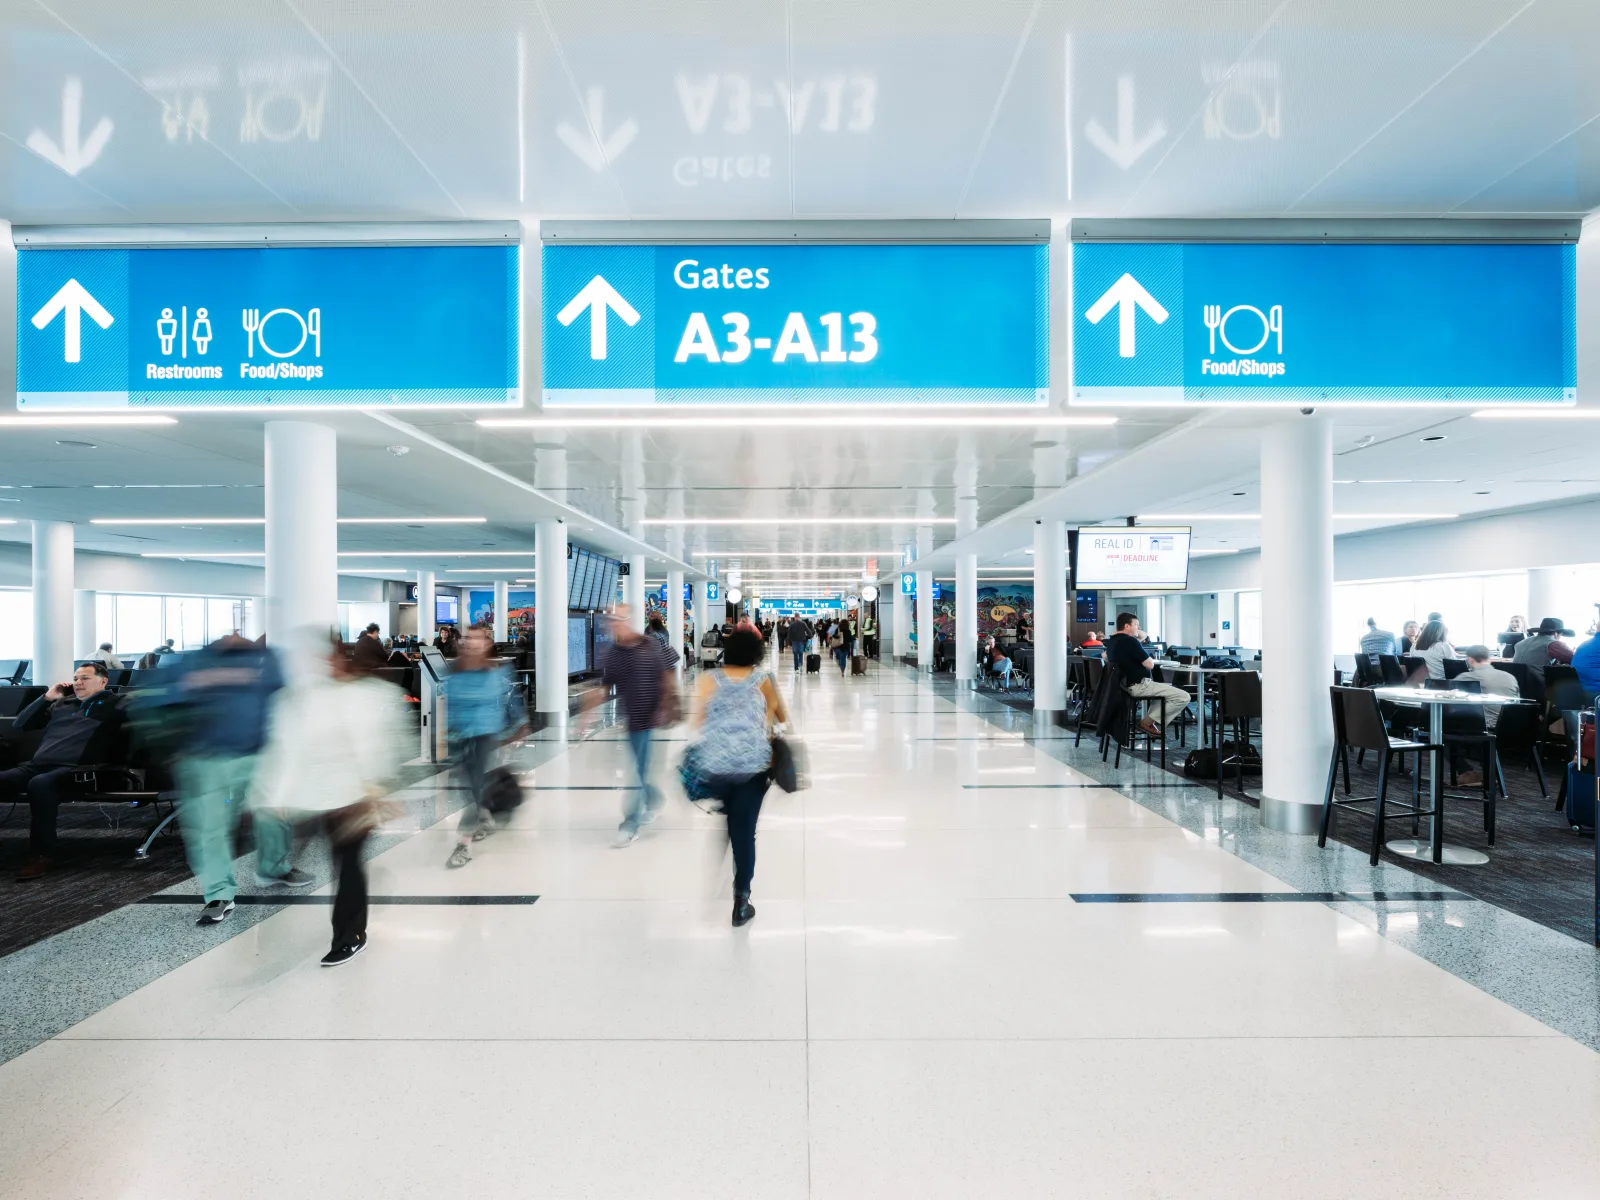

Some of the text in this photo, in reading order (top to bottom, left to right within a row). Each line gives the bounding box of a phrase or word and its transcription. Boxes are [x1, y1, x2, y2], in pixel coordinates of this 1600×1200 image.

[673, 259, 770, 290] Gates
[674, 311, 879, 364] A3-A13
[145, 363, 223, 380] Restrooms
[239, 361, 324, 381] Food/Shops
[1201, 358, 1286, 378] Food/Shops
[1094, 539, 1134, 548] REAL ID
